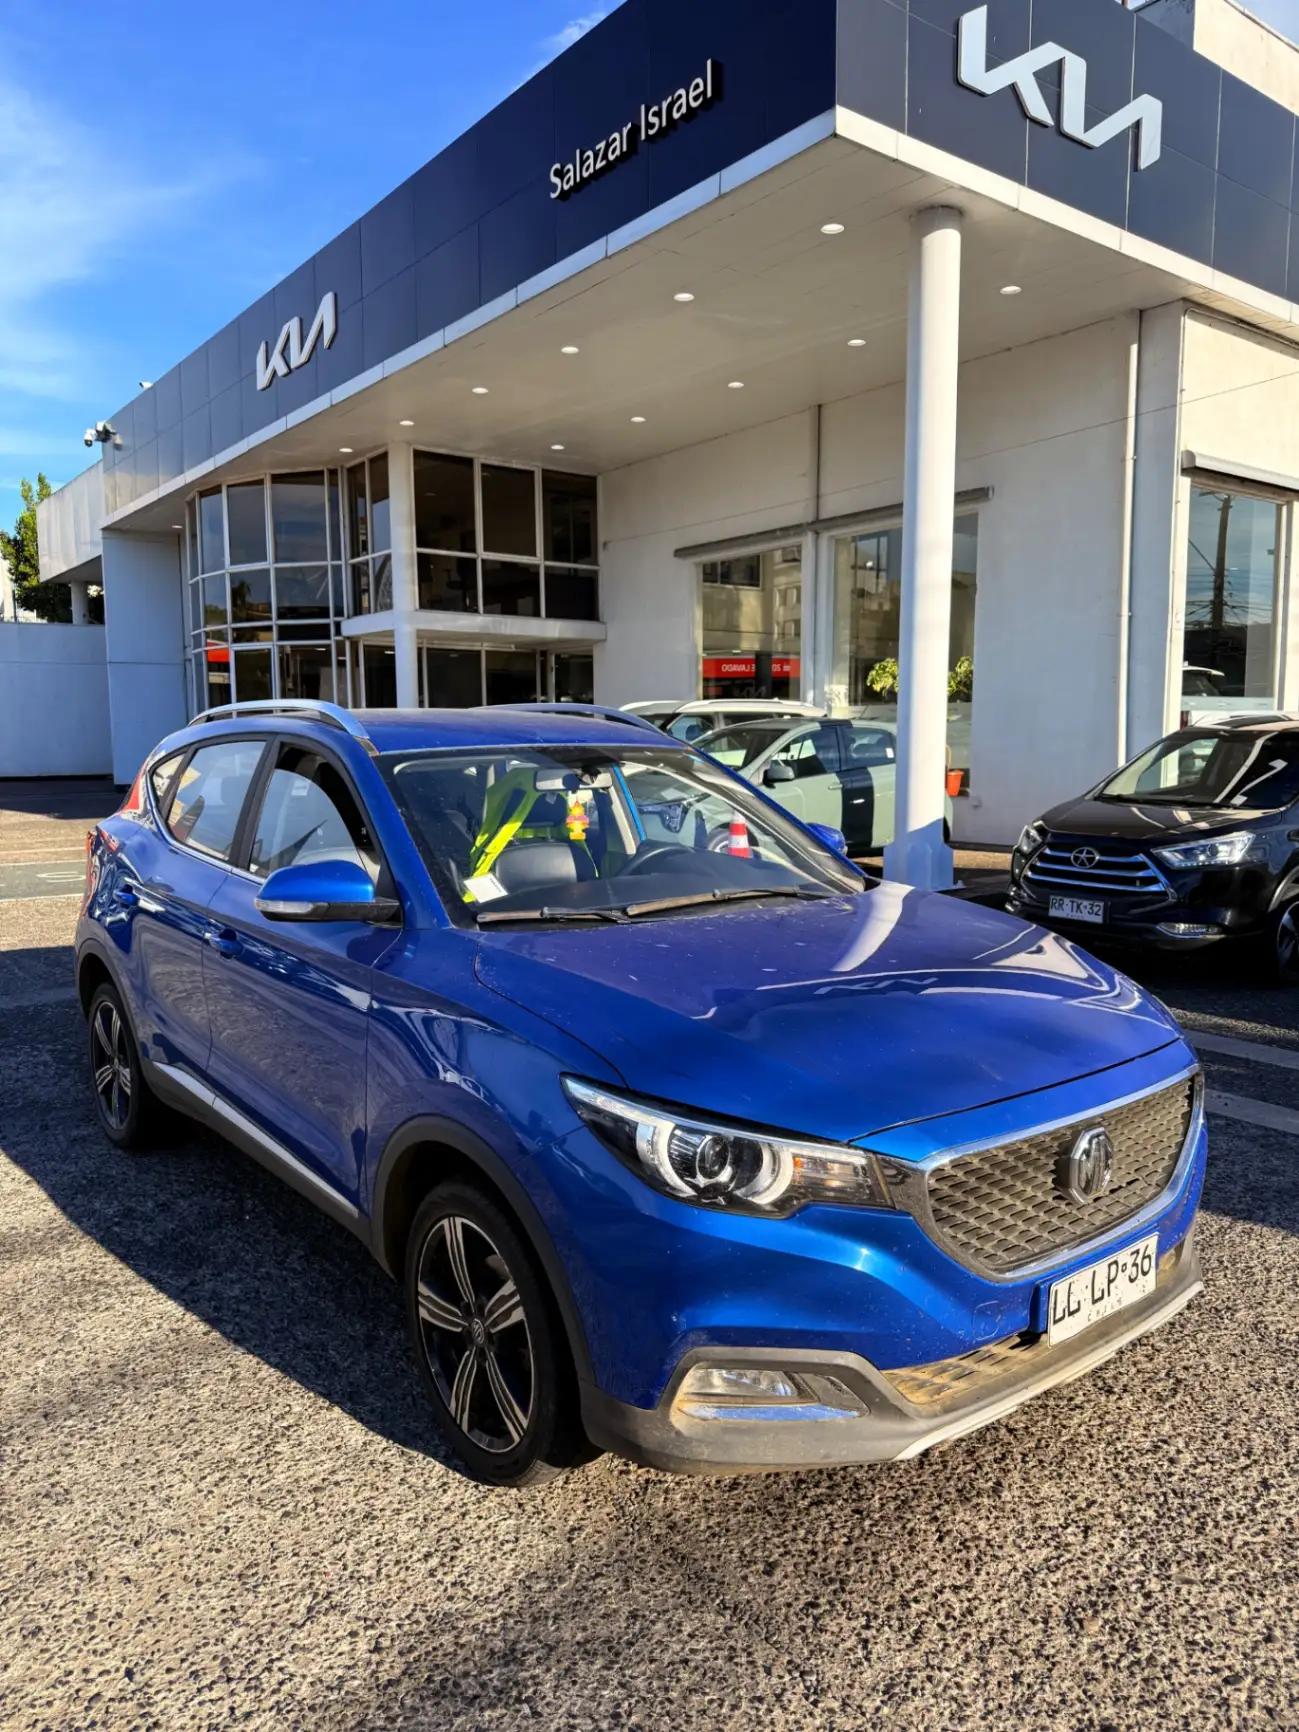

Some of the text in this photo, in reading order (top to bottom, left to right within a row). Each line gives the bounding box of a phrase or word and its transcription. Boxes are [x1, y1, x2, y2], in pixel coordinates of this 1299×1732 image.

[550, 58, 712, 199] Salazar Israel
[959, 4, 1163, 170] KIA
[256, 291, 336, 390] KIA
